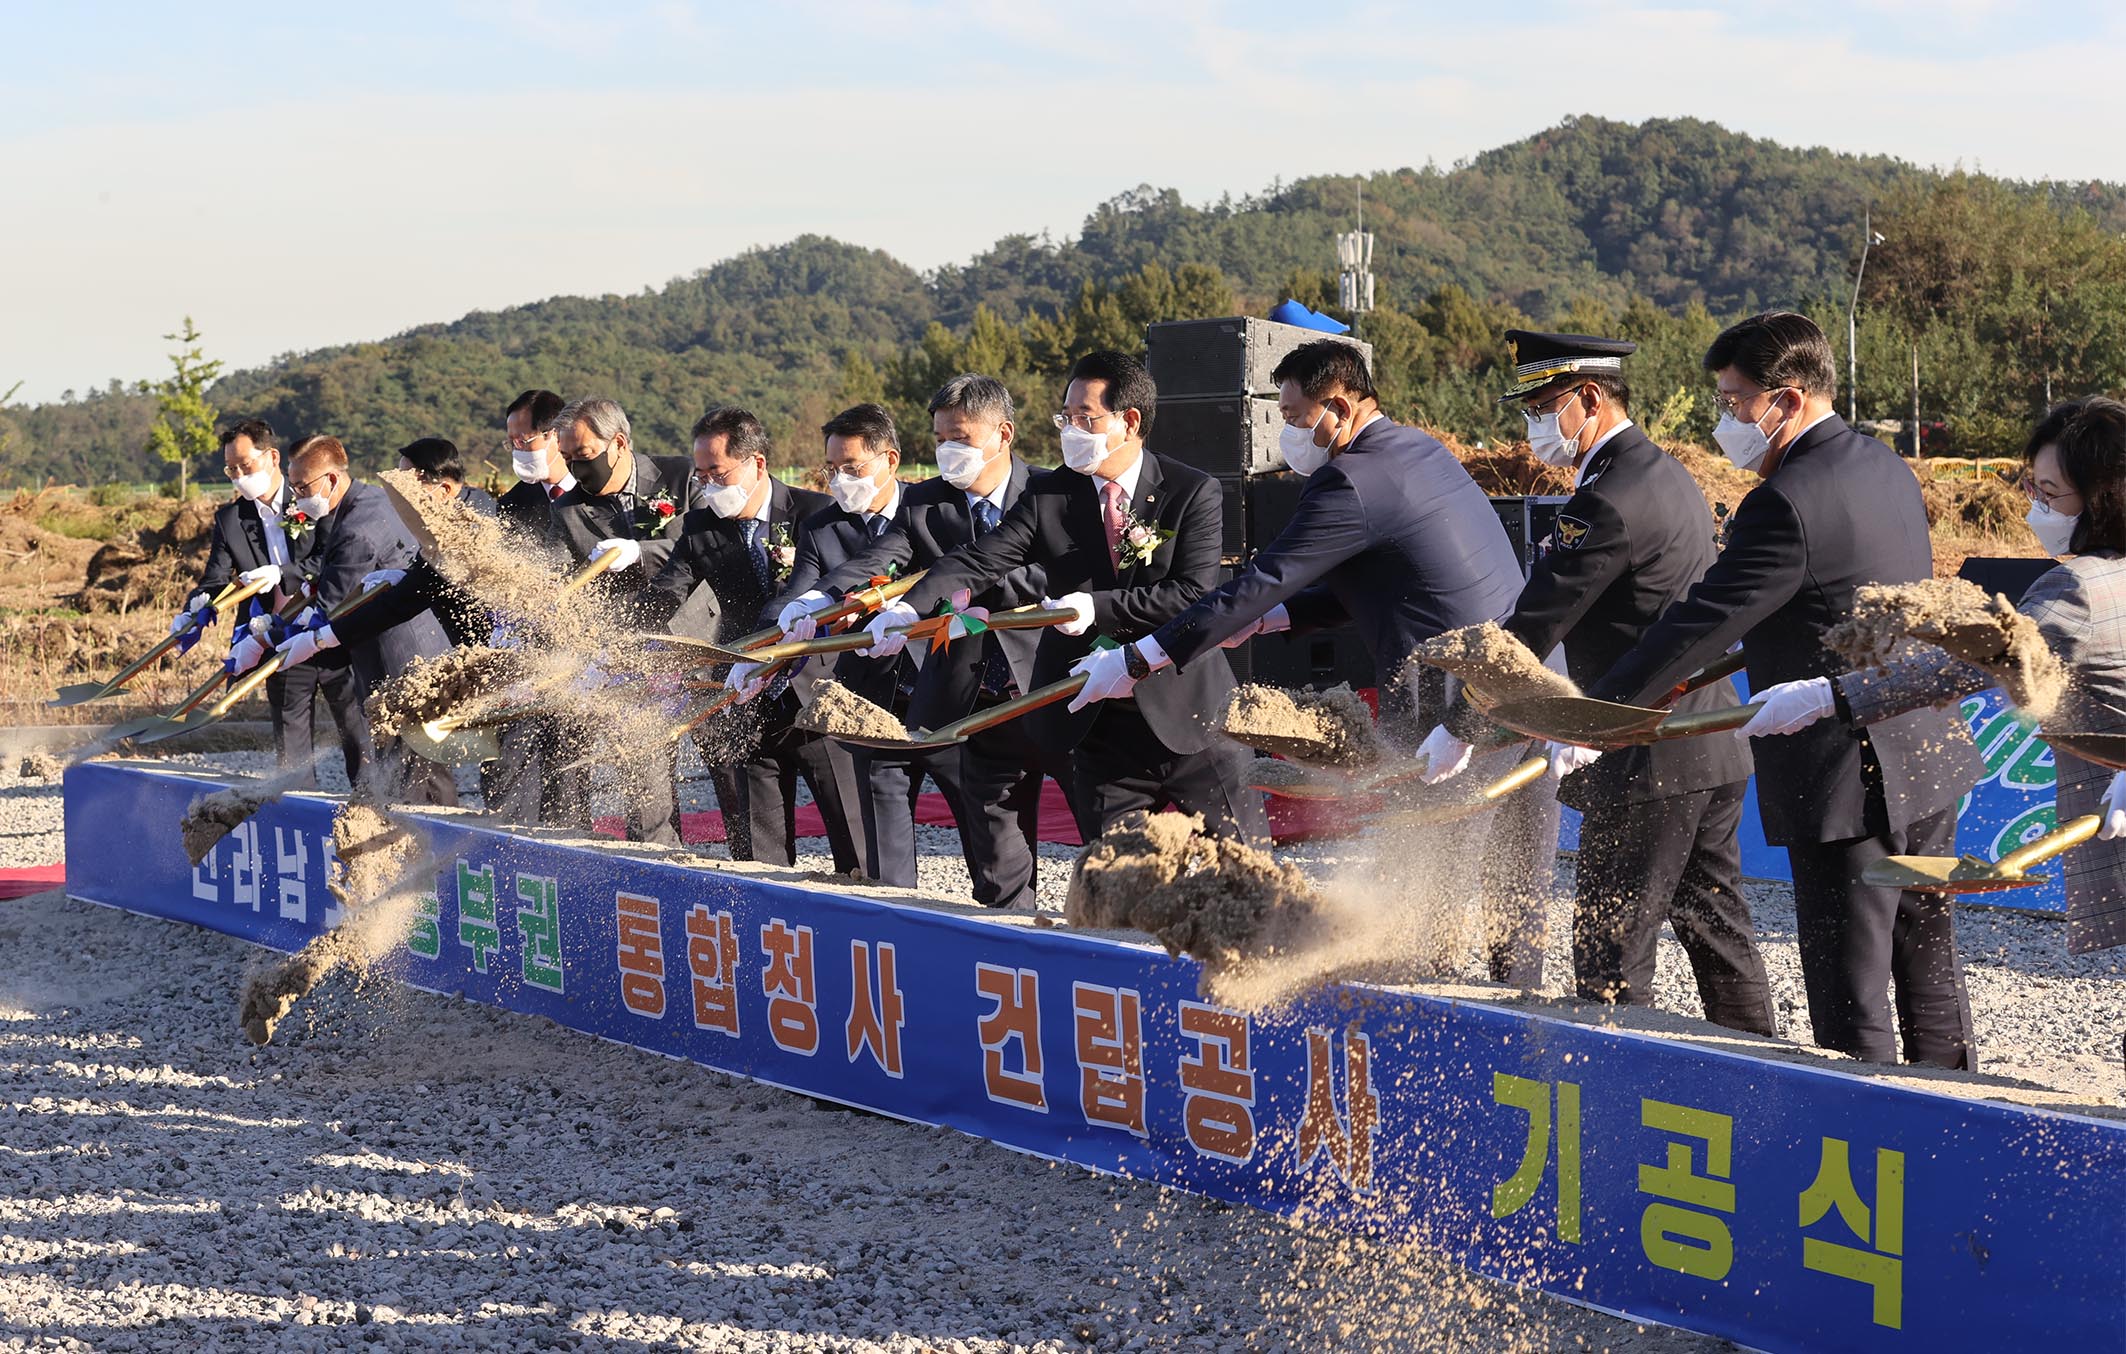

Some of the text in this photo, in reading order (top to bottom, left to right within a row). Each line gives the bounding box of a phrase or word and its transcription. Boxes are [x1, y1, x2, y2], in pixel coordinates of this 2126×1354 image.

[615, 890, 906, 1080] 통합청사
[975, 961, 1382, 1196] 건립공사
[1492, 1071, 1905, 1330] 기공식
